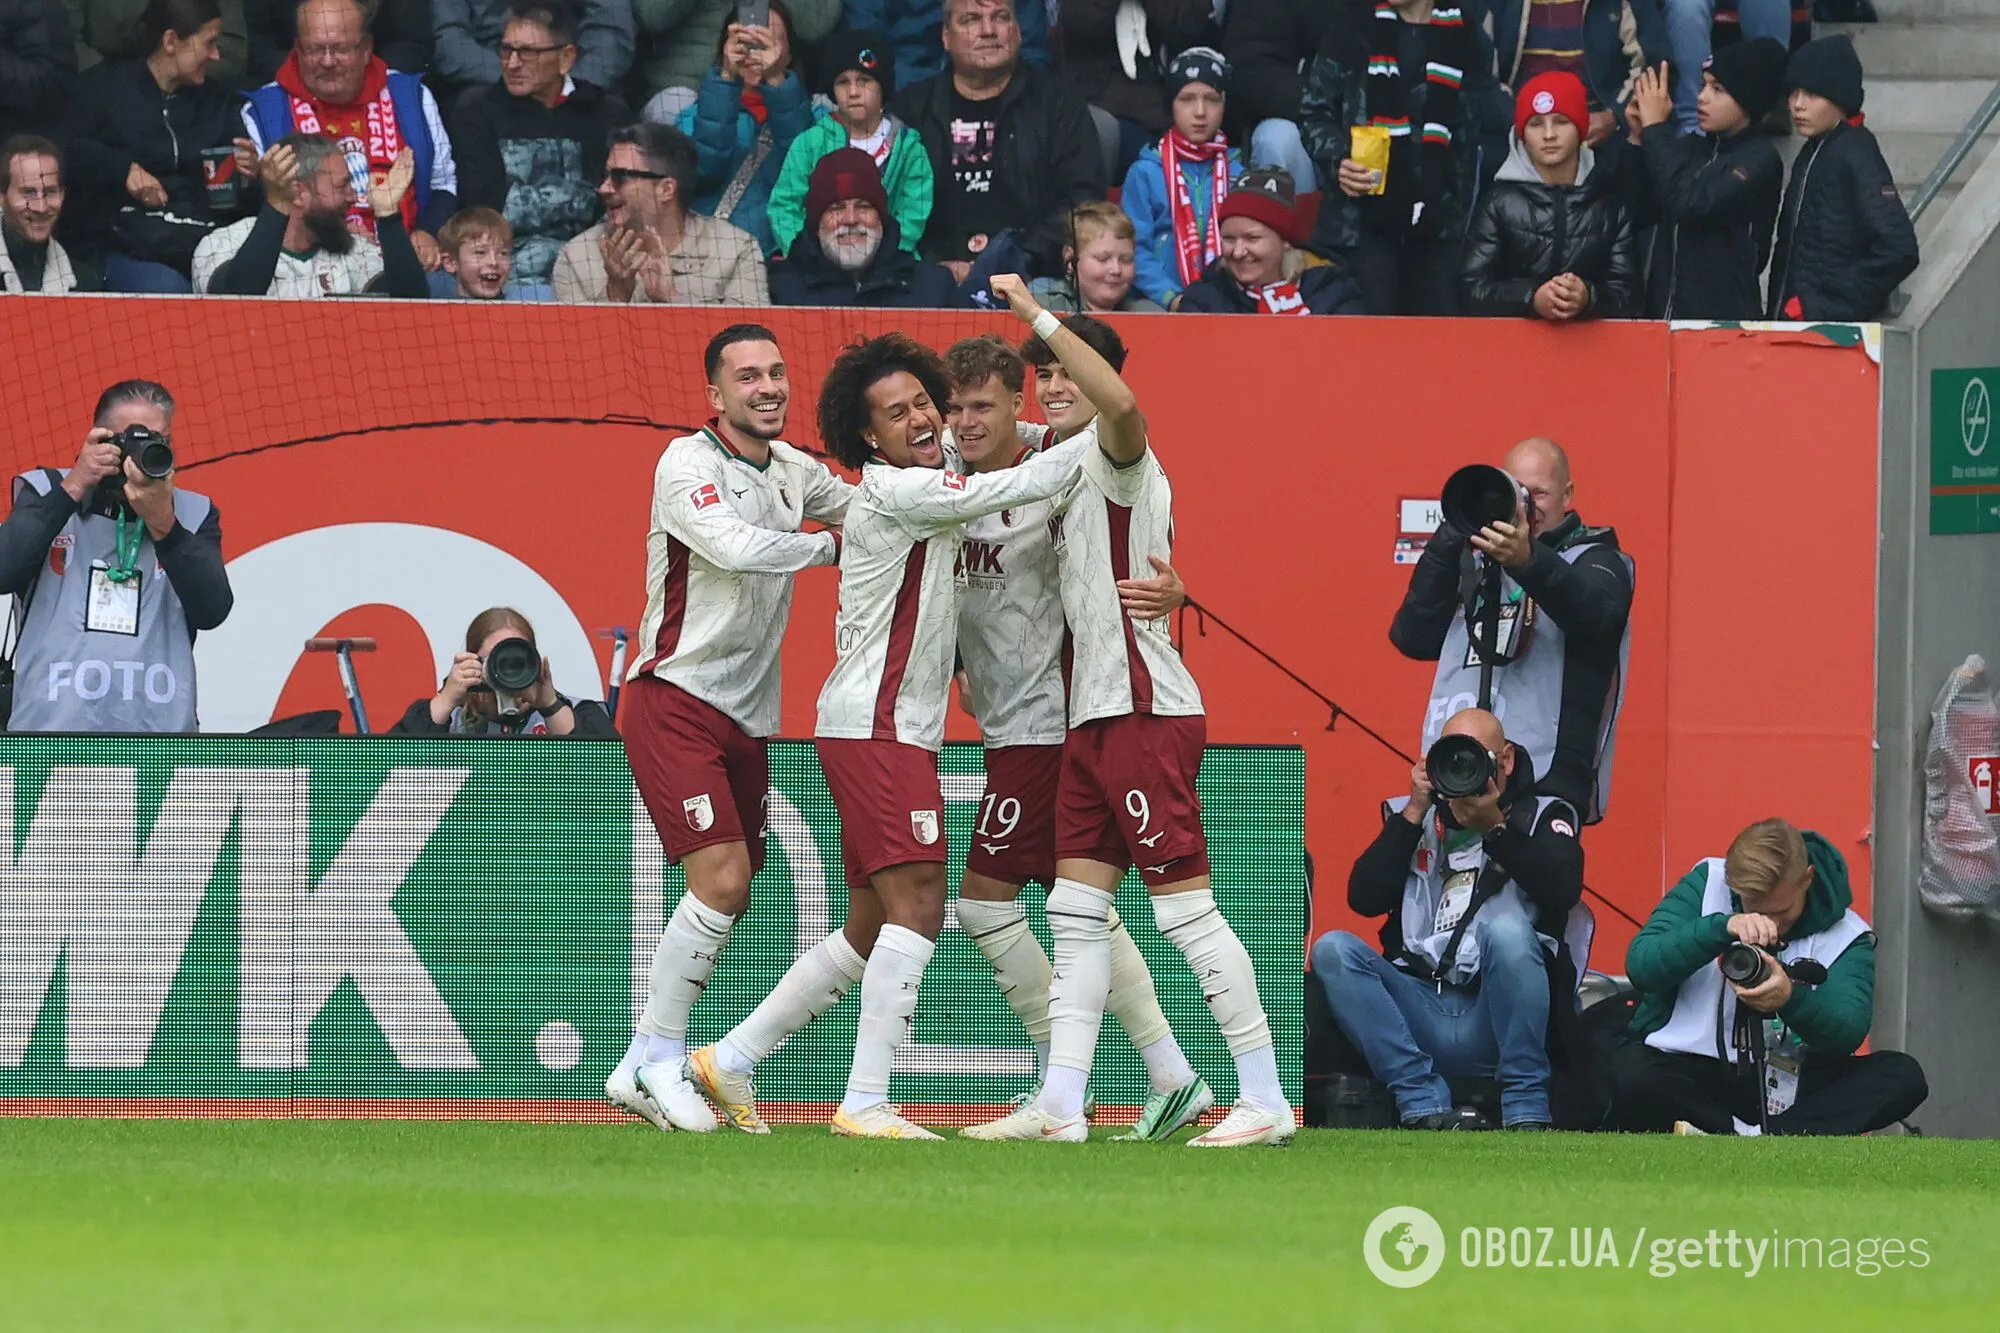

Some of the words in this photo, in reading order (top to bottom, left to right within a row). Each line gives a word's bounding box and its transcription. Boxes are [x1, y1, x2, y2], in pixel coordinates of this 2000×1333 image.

[48, 660, 176, 704] FOTO
[686, 796, 708, 808] FCA
[914, 812, 935, 820] FCA
[976, 792, 1021, 838] 19
[1125, 789, 1150, 835] 9
